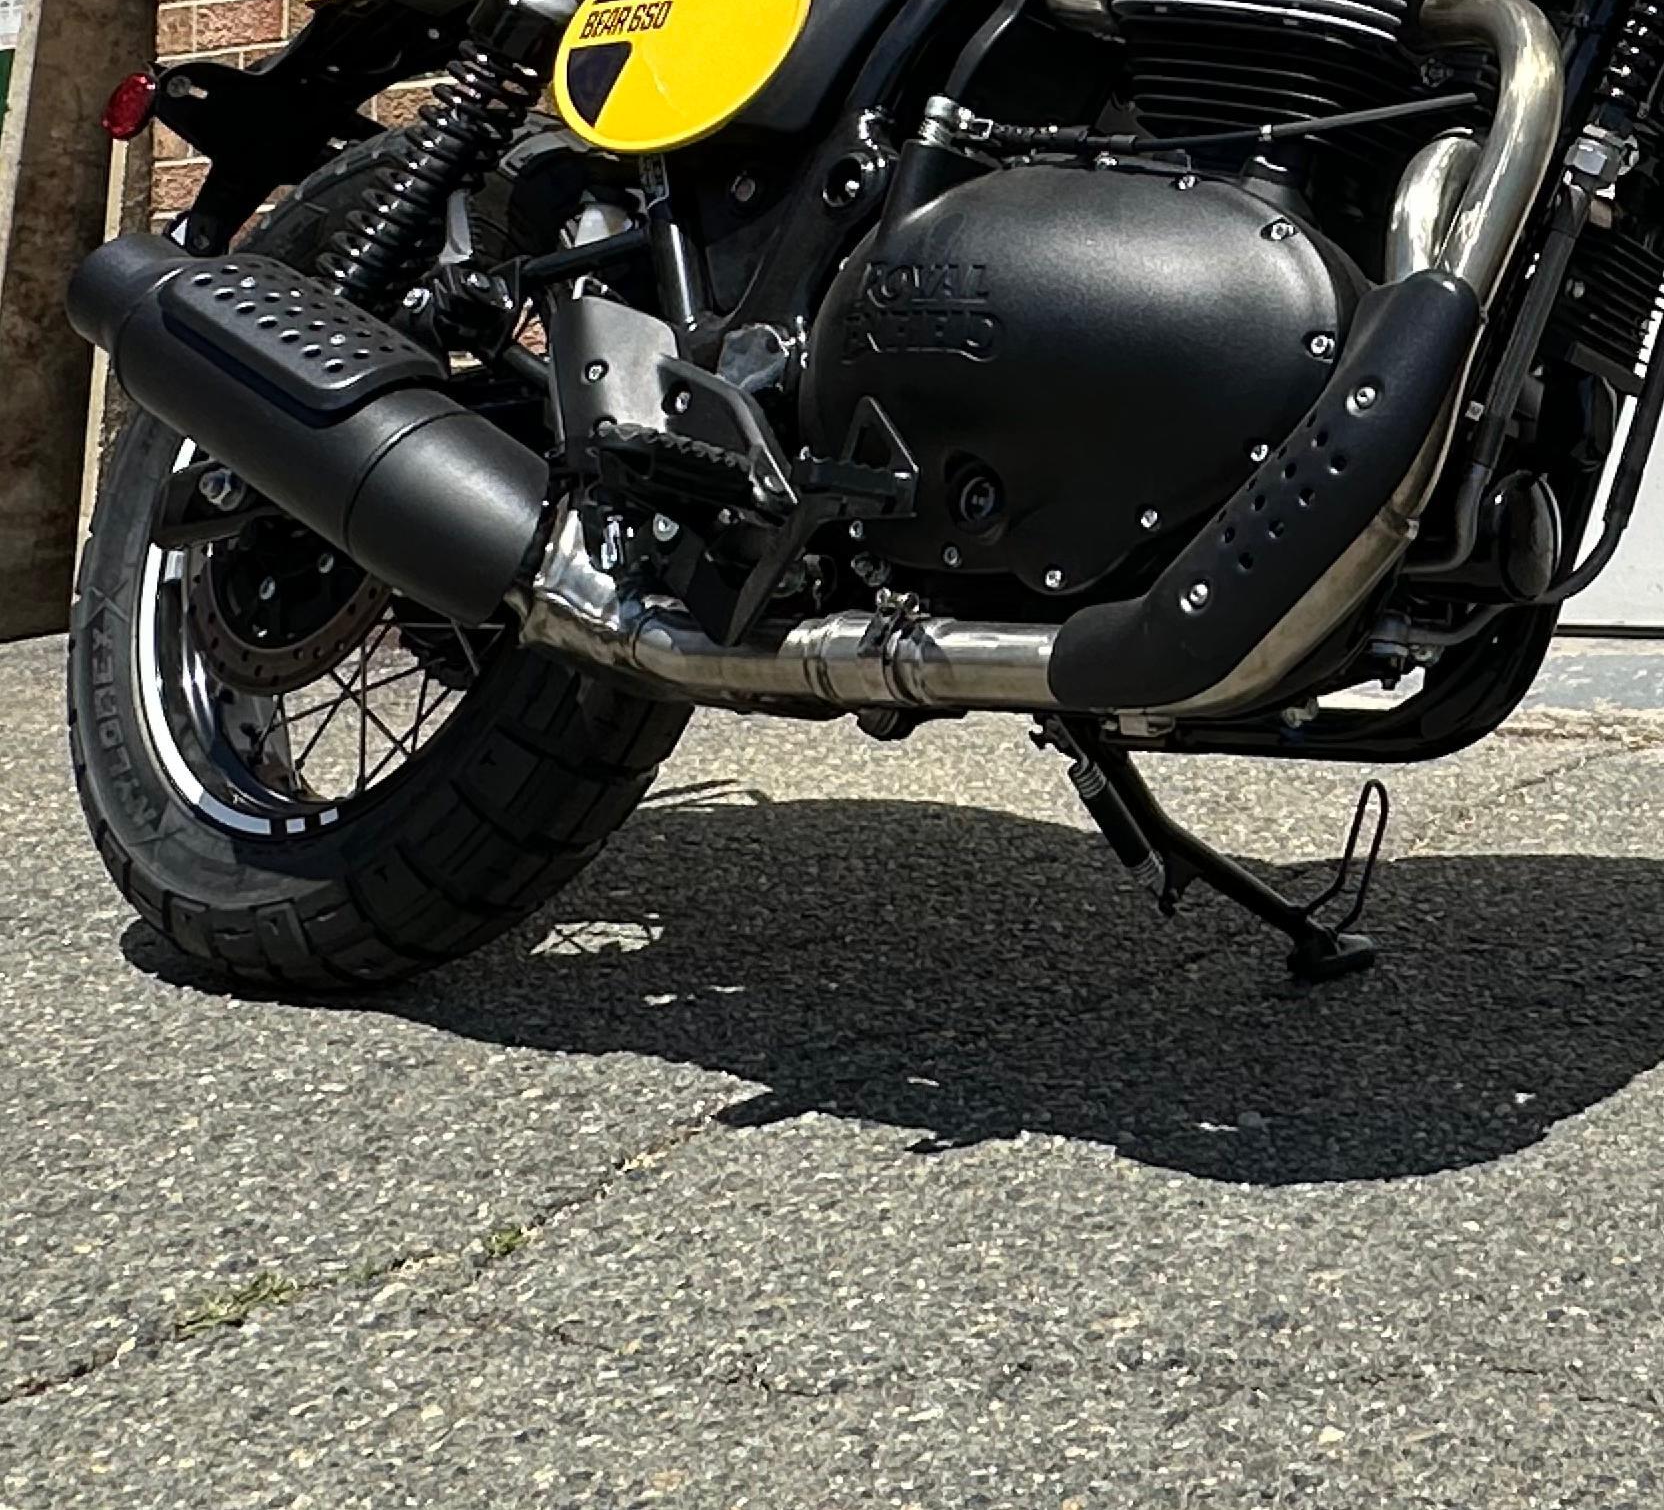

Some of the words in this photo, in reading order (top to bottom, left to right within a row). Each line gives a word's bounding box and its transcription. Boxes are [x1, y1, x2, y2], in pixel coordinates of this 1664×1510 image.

[579, 5, 633, 40] BEAR
[627, 0, 674, 33] 650
[860, 261, 989, 308] ROYAL
